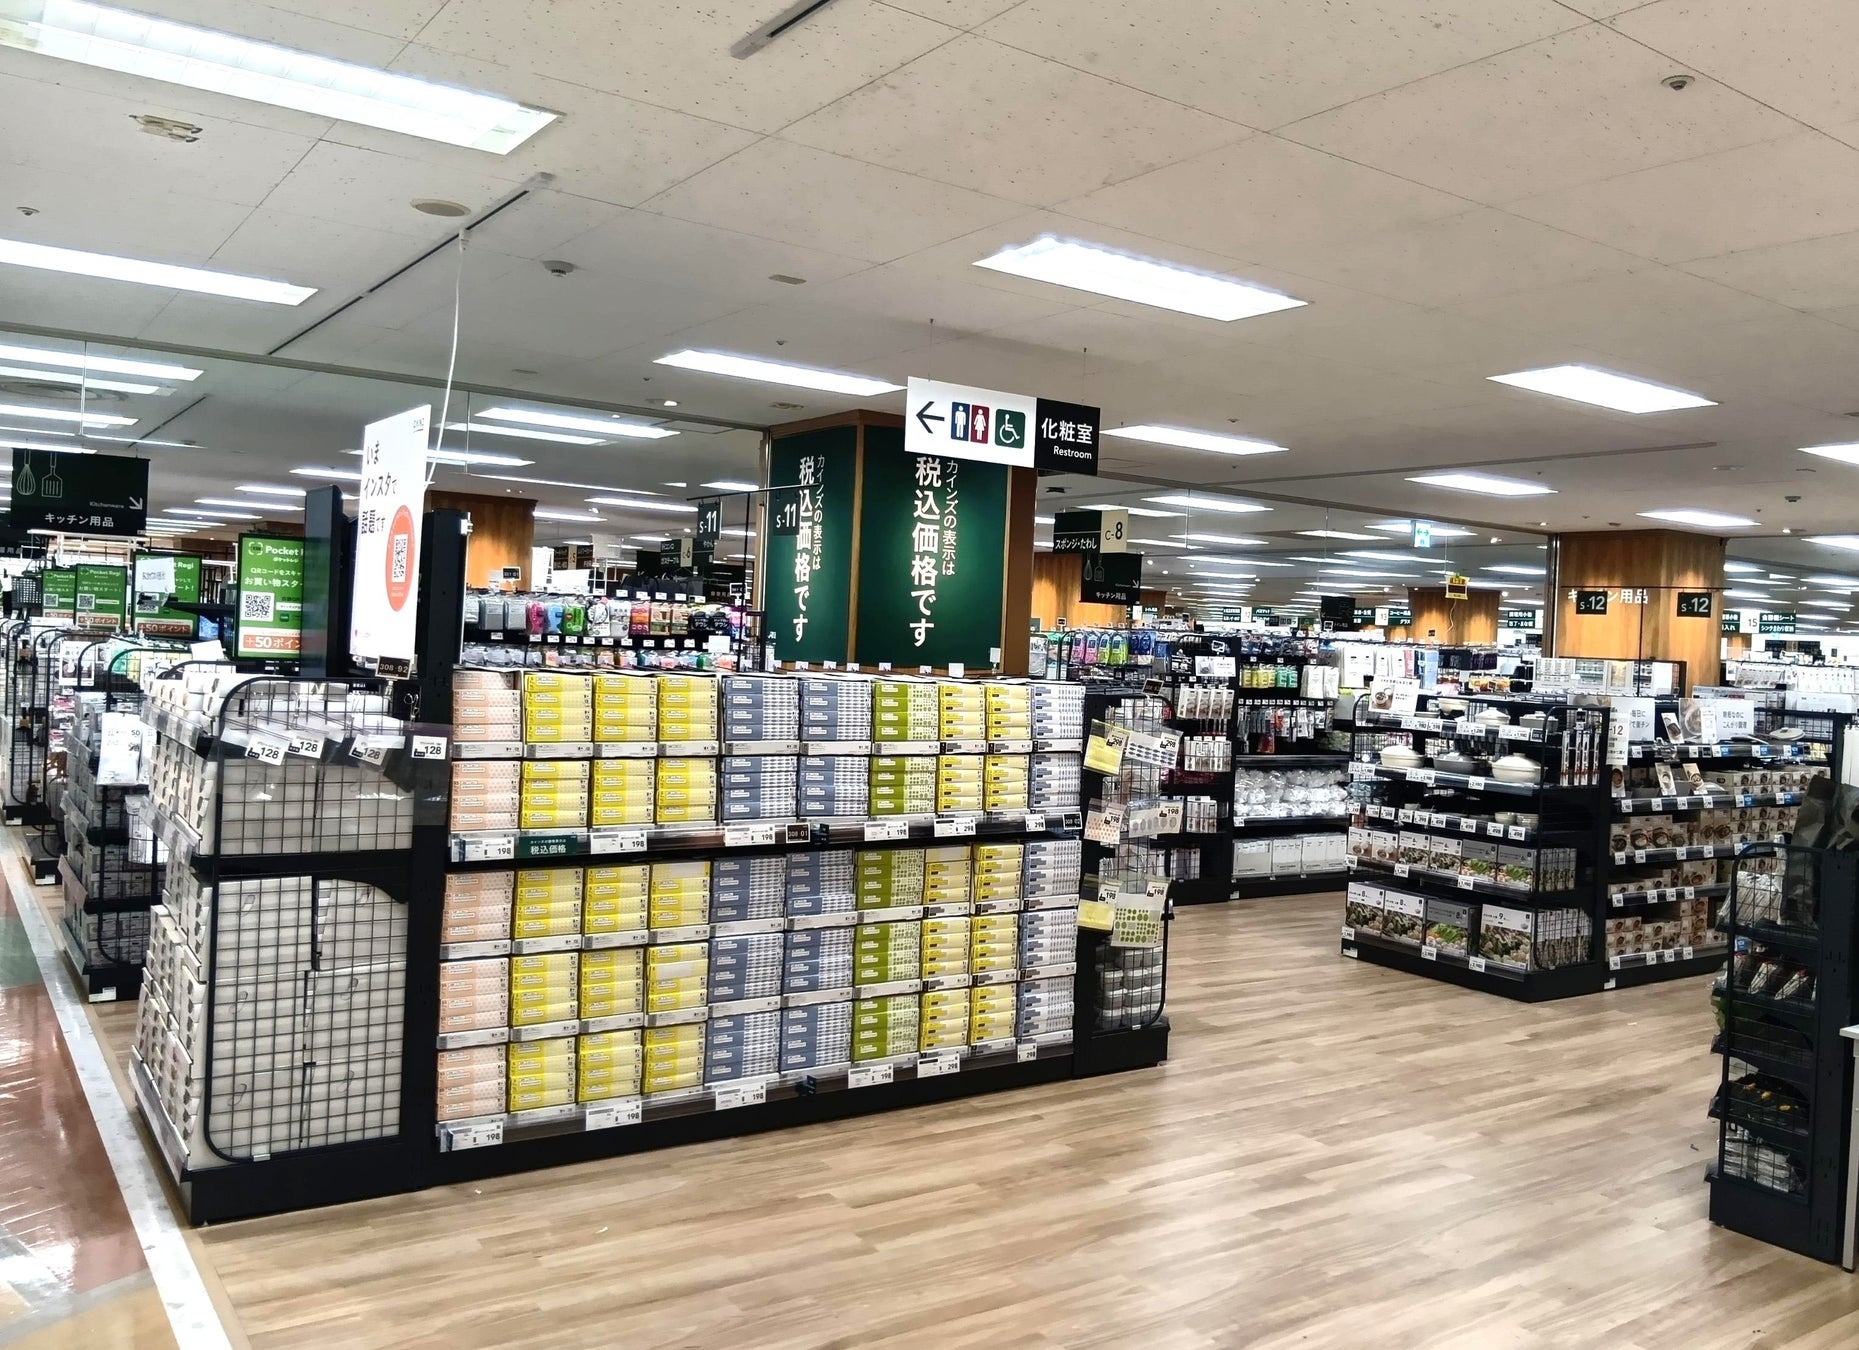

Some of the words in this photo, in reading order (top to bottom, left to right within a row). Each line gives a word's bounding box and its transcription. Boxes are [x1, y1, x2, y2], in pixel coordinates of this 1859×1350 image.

[1041, 417, 1093, 445] 化粧室
[367, 440, 380, 465] いま
[1053, 445, 1092, 460] Restroom
[364, 472, 397, 499] インスタで
[45, 512, 114, 528] キッチン用品
[941, 460, 959, 576] カインズの表示は
[1104, 521, 1123, 541] C-8
[793, 455, 815, 643] 税込価格です
[1055, 537, 1097, 550] スポンジ・たわし
[265, 545, 299, 556] Pocket
[909, 456, 942, 648] 税込価格です
[1095, 591, 1127, 600] キッチン用品
[1568, 588, 1648, 604] キン用品
[1580, 596, 1605, 610] S-12
[1681, 597, 1709, 612] S-12
[1748, 618, 1758, 627] 15
[299, 741, 318, 753] 128
[1112, 738, 1123, 747] 298
[1165, 740, 1176, 748] 298
[260, 747, 280, 759] 128
[362, 747, 382, 760] 128
[424, 745, 442, 755] 128
[1110, 816, 1120, 824] 198
[530, 844, 567, 856] 税込価格
[632, 840, 645, 848] 198
[497, 847, 512, 855] 198
[1106, 892, 1116, 900] 198
[1154, 888, 1165, 896] 198
[1026, 1051, 1036, 1059] 298
[947, 1062, 958, 1070] 298
[752, 1092, 764, 1101] 198
[627, 1112, 640, 1120] 198
[486, 1133, 500, 1141] 198
